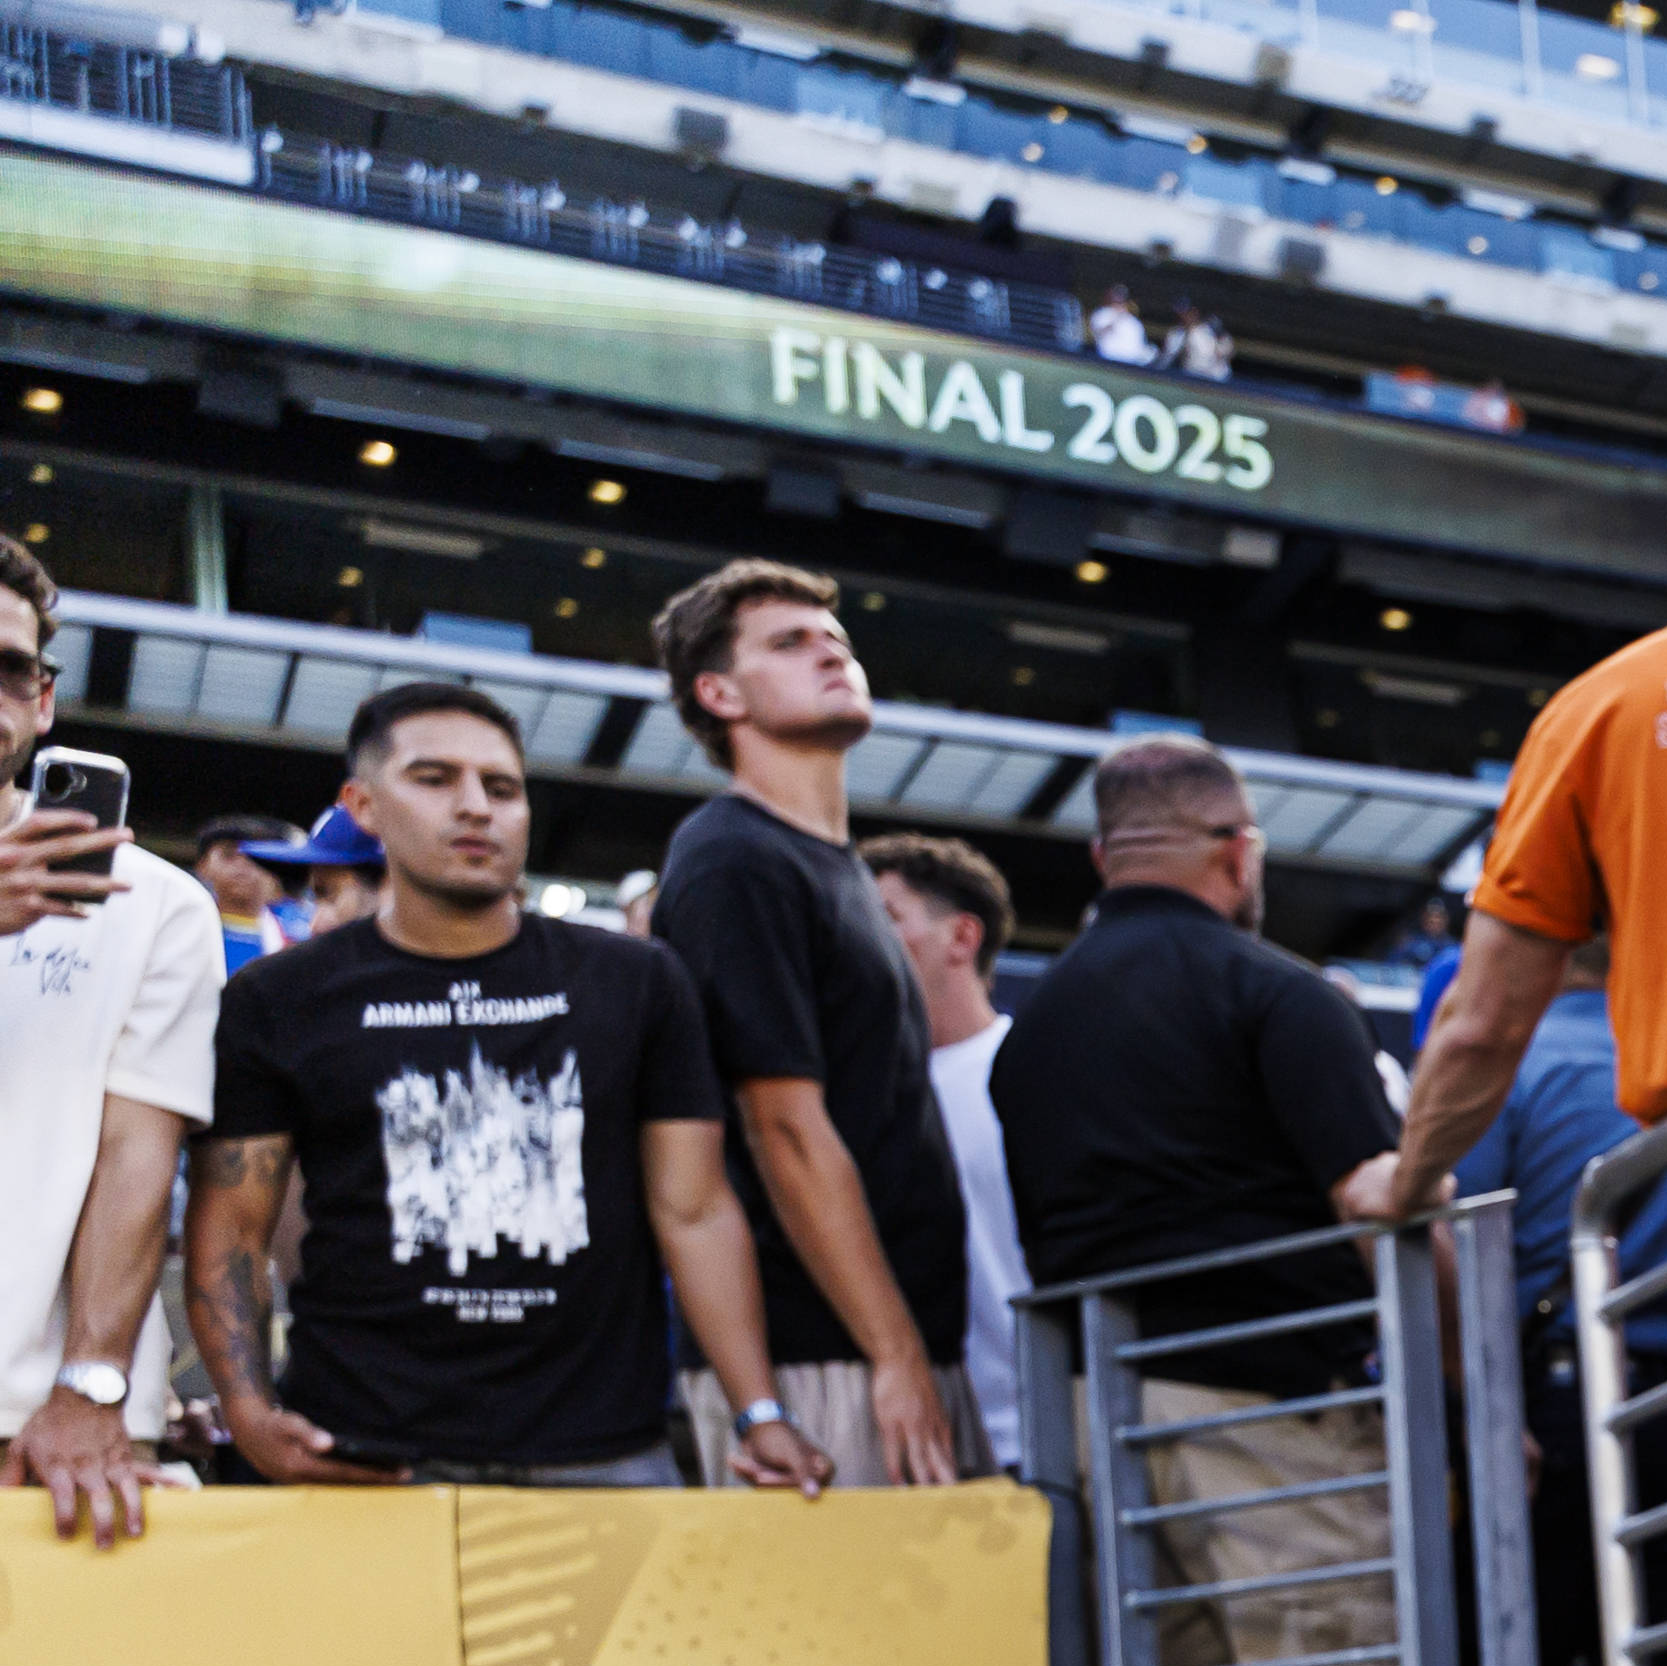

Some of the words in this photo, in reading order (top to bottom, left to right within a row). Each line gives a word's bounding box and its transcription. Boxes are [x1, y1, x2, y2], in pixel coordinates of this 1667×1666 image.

[770, 327, 1055, 453] FINAL
[1061, 383, 1275, 491] 2025
[361, 1000, 452, 1028] ARMANI
